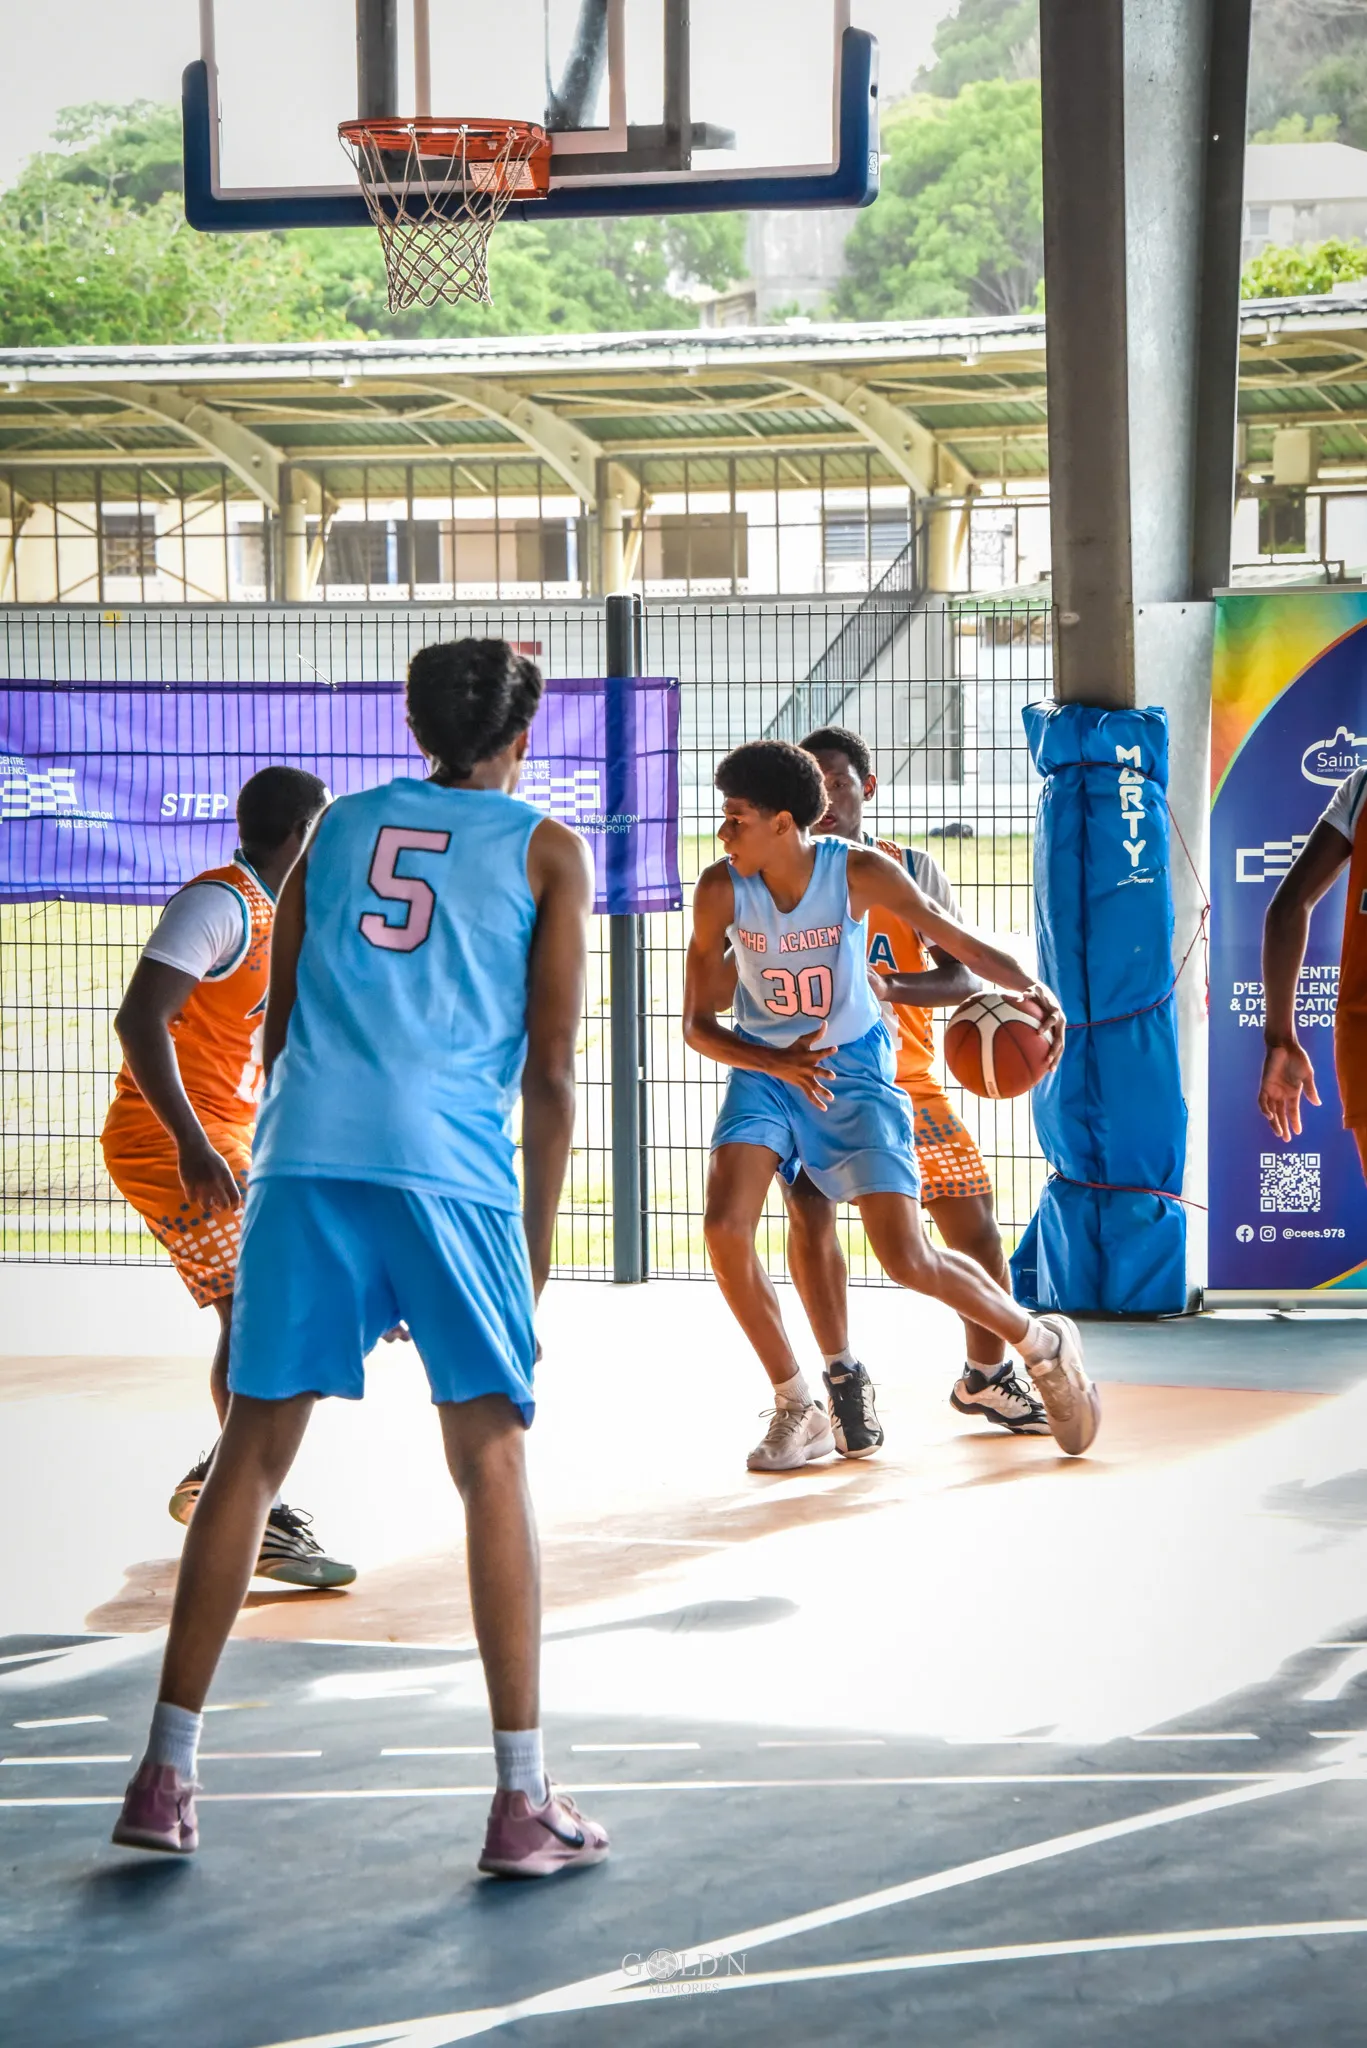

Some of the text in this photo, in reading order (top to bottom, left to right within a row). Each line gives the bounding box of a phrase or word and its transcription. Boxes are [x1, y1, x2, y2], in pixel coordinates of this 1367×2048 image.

[522, 760, 550, 769] ENTRE
[160, 792, 229, 818] STEP
[56, 820, 72, 828] PAR
[73, 820, 84, 828] LE
[575, 825, 632, 834] PAR LE SPORT
[359, 825, 452, 953] 5
[1299, 966, 1340, 979] ENTR
[761, 965, 833, 1019] 30
[1230, 998, 1241, 1011] &
[1282, 1228, 1346, 1239] @cees.978
